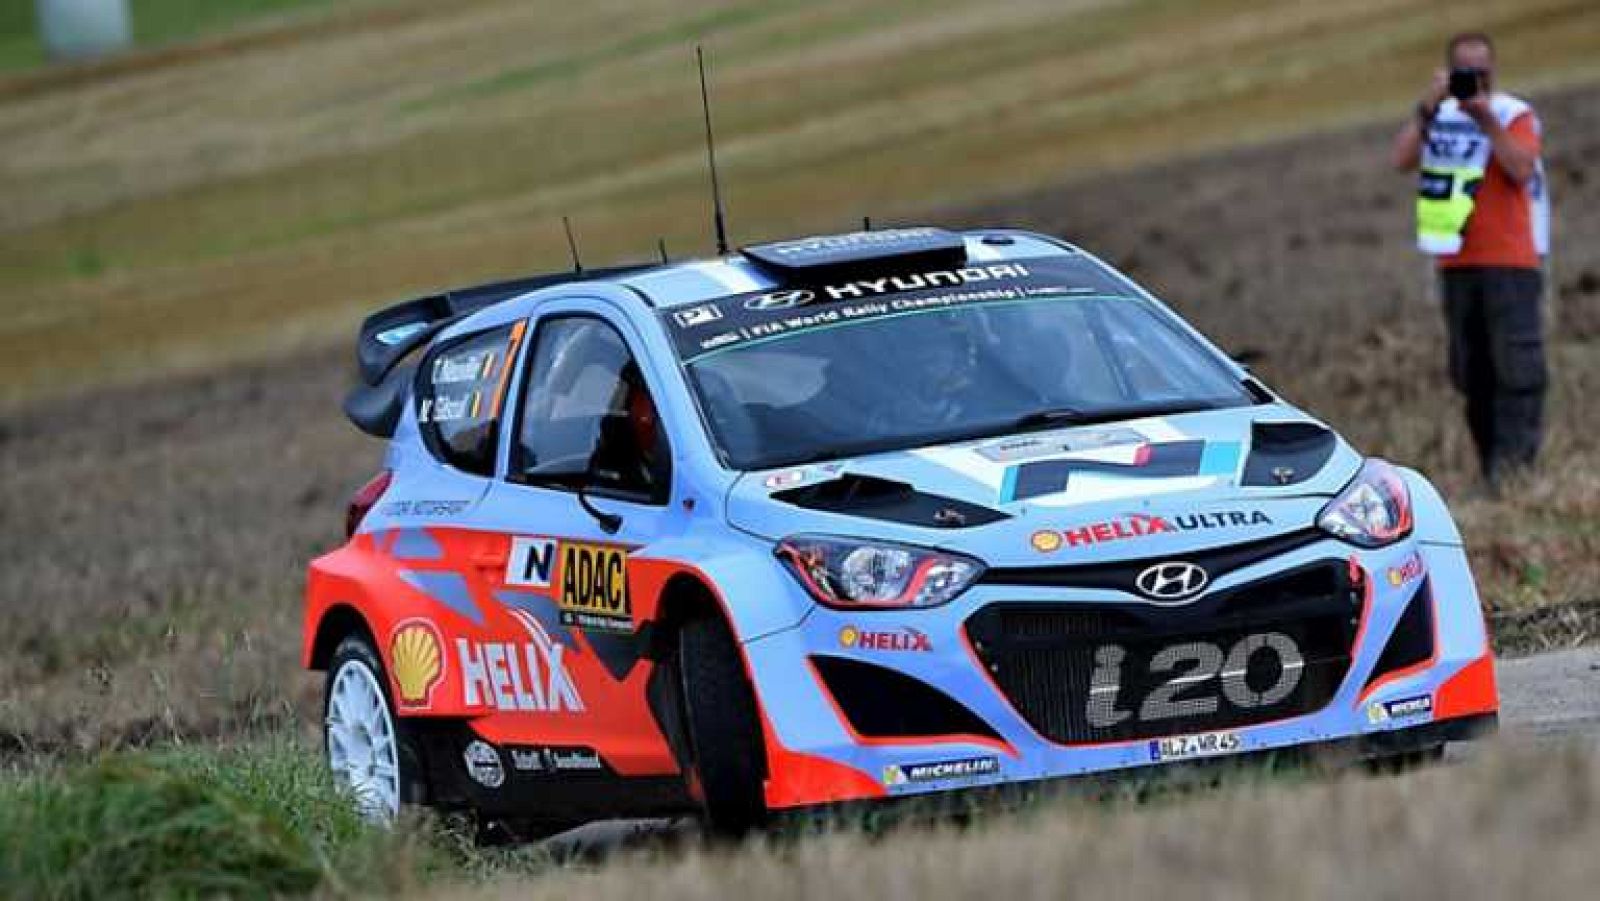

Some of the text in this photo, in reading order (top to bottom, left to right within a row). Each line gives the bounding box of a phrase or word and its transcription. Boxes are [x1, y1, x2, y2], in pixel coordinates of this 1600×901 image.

[825, 262, 1030, 299] HYUNDAI
[784, 310, 839, 330] World
[842, 303, 888, 318] Rally
[1063, 510, 1273, 546] HELIX ULTRA
[523, 543, 554, 581] N
[564, 547, 623, 609] ADAC
[859, 631, 933, 651] HELIX
[455, 626, 585, 713] HELIX
[1085, 632, 1303, 728] i20
[909, 758, 995, 778] MICHELIN
